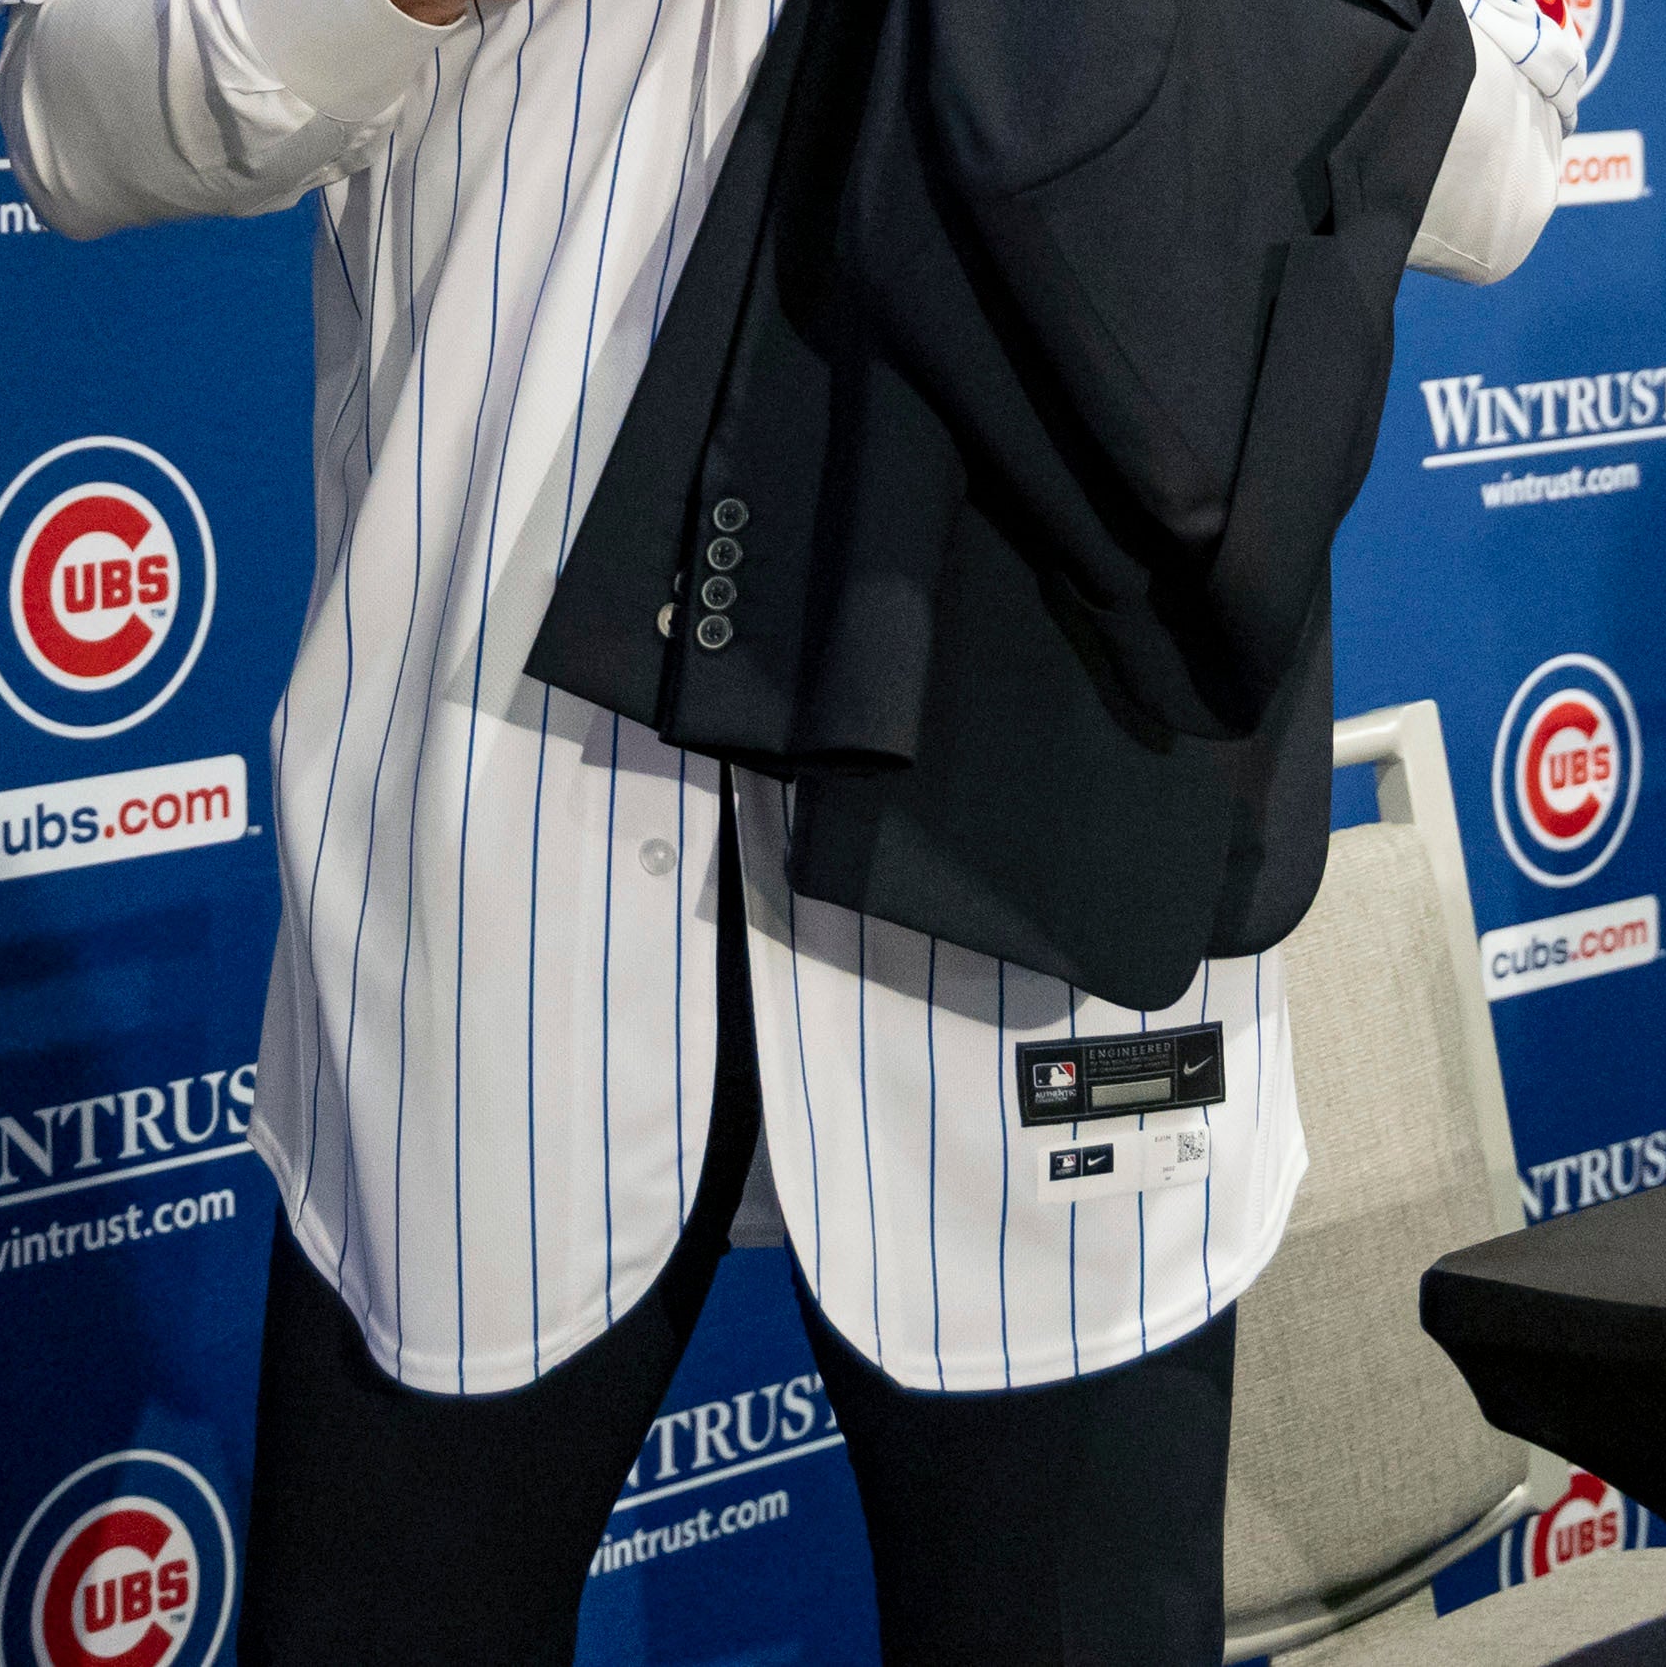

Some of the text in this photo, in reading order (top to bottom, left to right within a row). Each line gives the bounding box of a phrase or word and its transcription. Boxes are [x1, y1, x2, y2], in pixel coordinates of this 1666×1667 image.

[1482, 463, 1640, 509] wintrust.com
[22, 496, 170, 677] CUBS
[1533, 700, 1611, 839] CUBS
[1491, 917, 1649, 980] cubs.com
[1089, 1042, 1171, 1060] ENGINEERED
[627, 1374, 836, 1486] TRUS
[43, 1509, 189, 1667] CUBS
